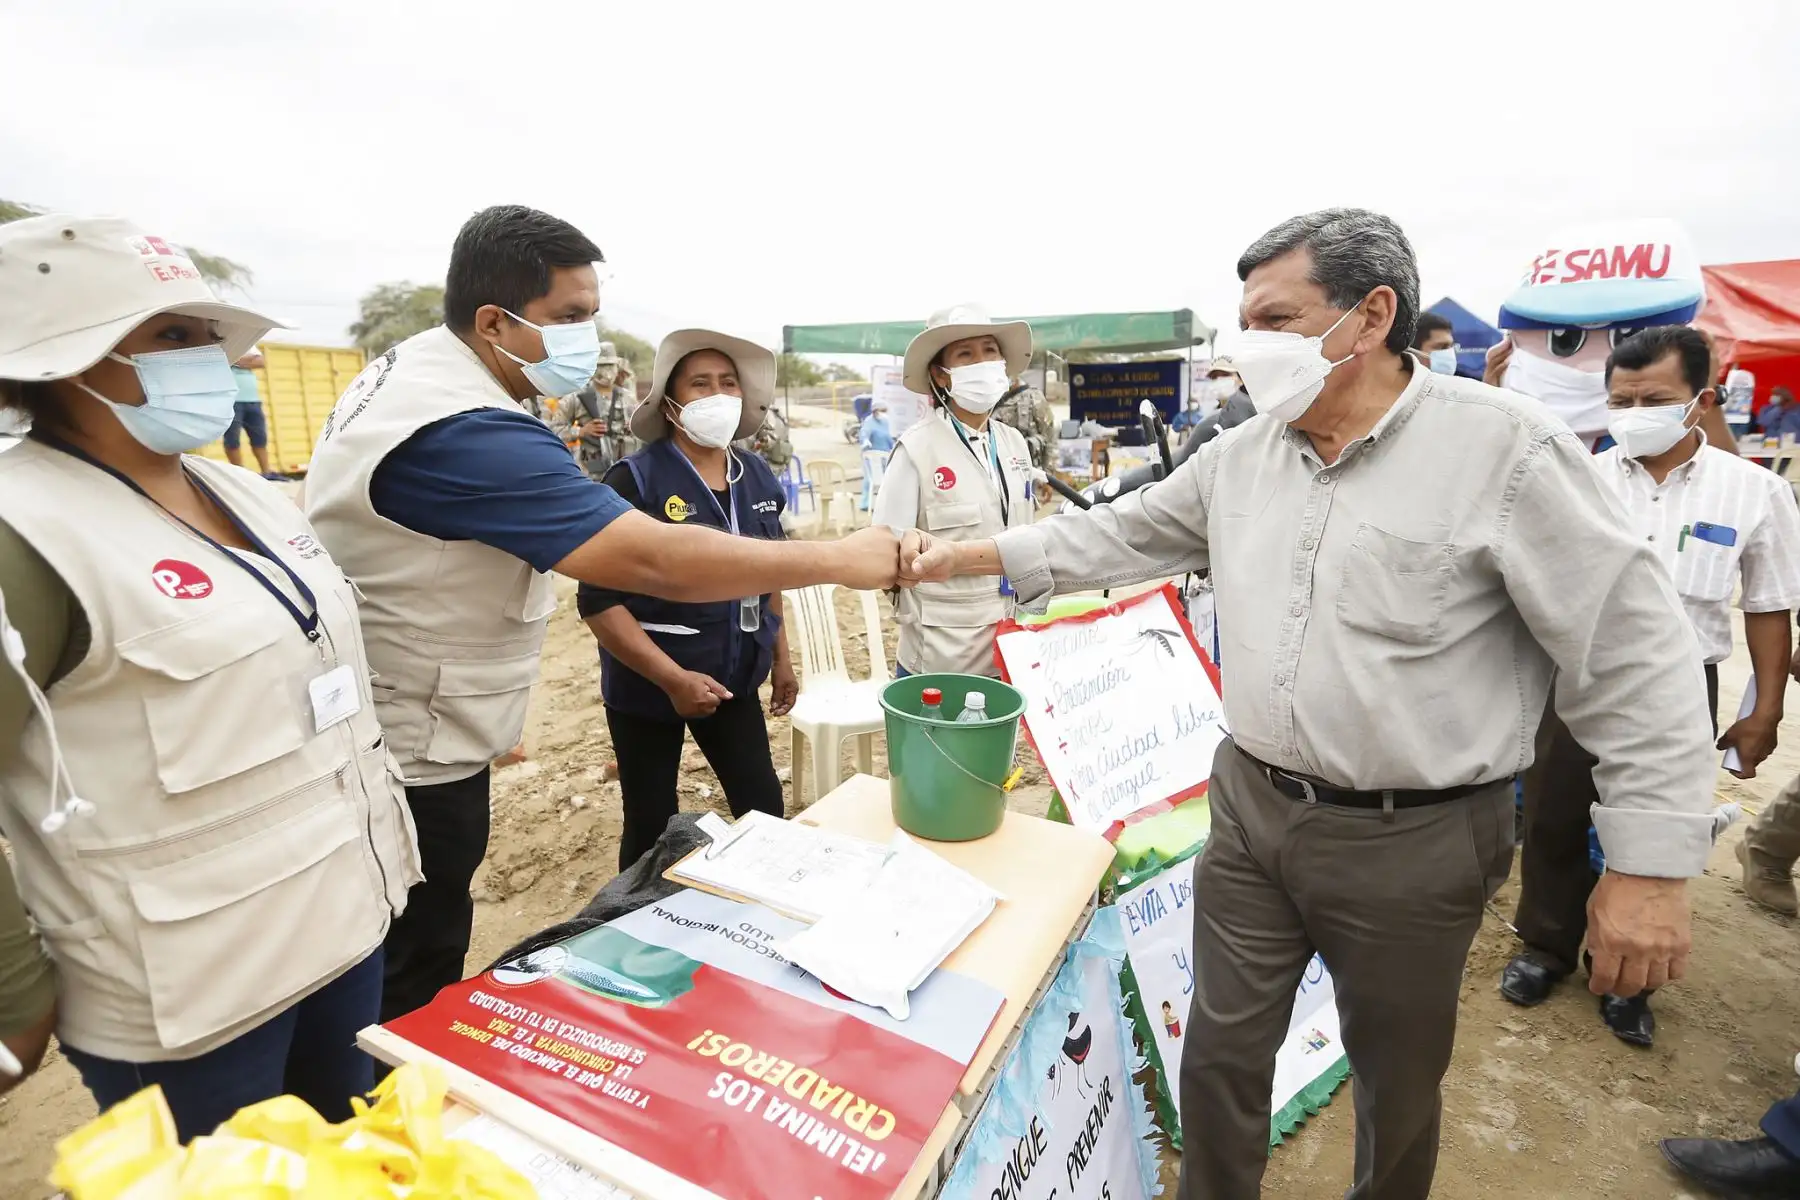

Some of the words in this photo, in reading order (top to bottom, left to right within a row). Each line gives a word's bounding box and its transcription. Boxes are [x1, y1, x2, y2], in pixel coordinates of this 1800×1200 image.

[1560, 244, 1671, 283] SAMU
[1098, 726, 1165, 777] ciudad
[1172, 702, 1219, 740] libre
[652, 906, 719, 932] REGIONAL
[739, 922, 775, 942] LUD
[468, 989, 527, 1020] LOCALIDAD
[487, 1018, 516, 1036] ZIKA
[525, 1012, 539, 1028] TU
[541, 1017, 555, 1033] EN
[490, 1036, 512, 1050] DEL
[512, 1027, 525, 1039] EL
[522, 1032, 536, 1044] Y
[556, 1023, 630, 1059] REPRODUZCA
[509, 1043, 567, 1073] ZANCUDO
[535, 1035, 616, 1073] CHIKUNGUNYA
[628, 1049, 647, 1065] SE
[563, 1064, 577, 1080] EL
[575, 1069, 605, 1088] QUE
[613, 1063, 633, 1081] LA
[601, 1079, 641, 1105] EVITA
[686, 1029, 896, 1141] CRIADEROS!
[707, 1072, 766, 1113] LOS
[638, 1095, 650, 1110] Y
[1066, 1075, 1114, 1193] PREVENIR
